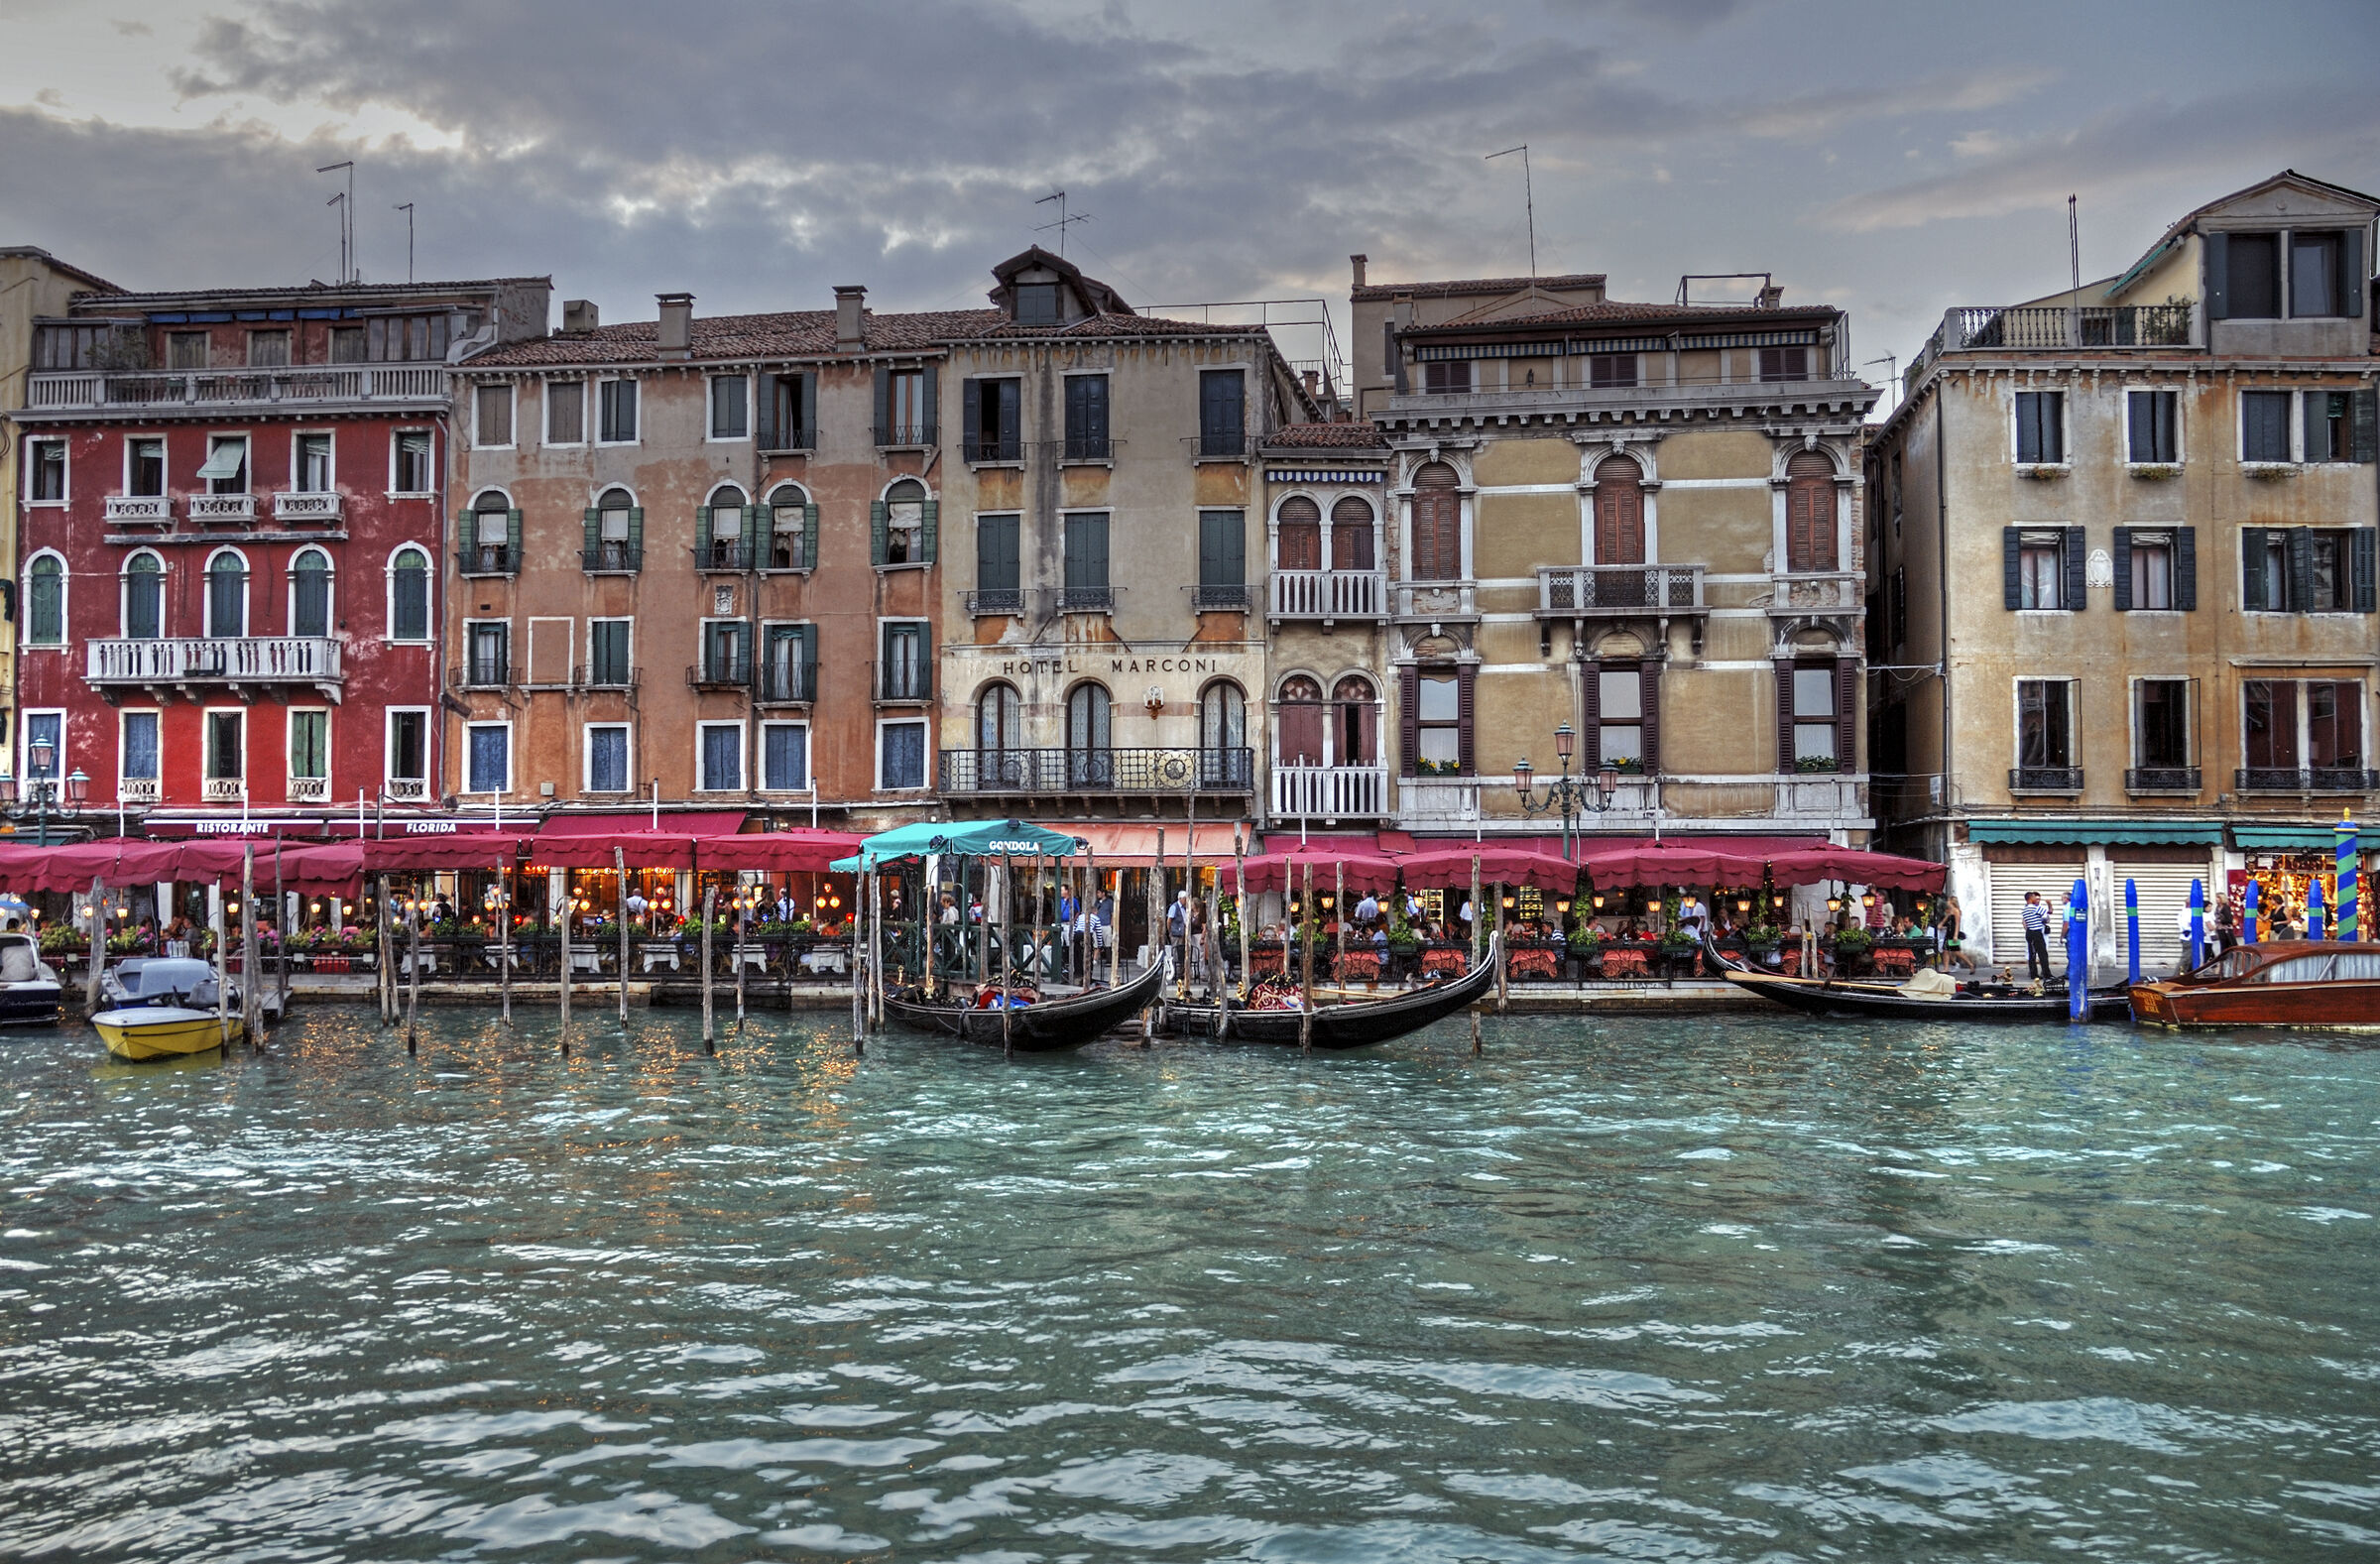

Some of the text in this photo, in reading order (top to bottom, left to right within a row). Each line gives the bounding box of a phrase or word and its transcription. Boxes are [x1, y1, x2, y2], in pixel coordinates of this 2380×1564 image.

[1004, 659, 1217, 674] HOTEL MARCONI
[196, 823, 269, 833] RISTORANTE
[406, 823, 456, 832] FLORIDA
[989, 840, 1039, 851] GONDOLA
